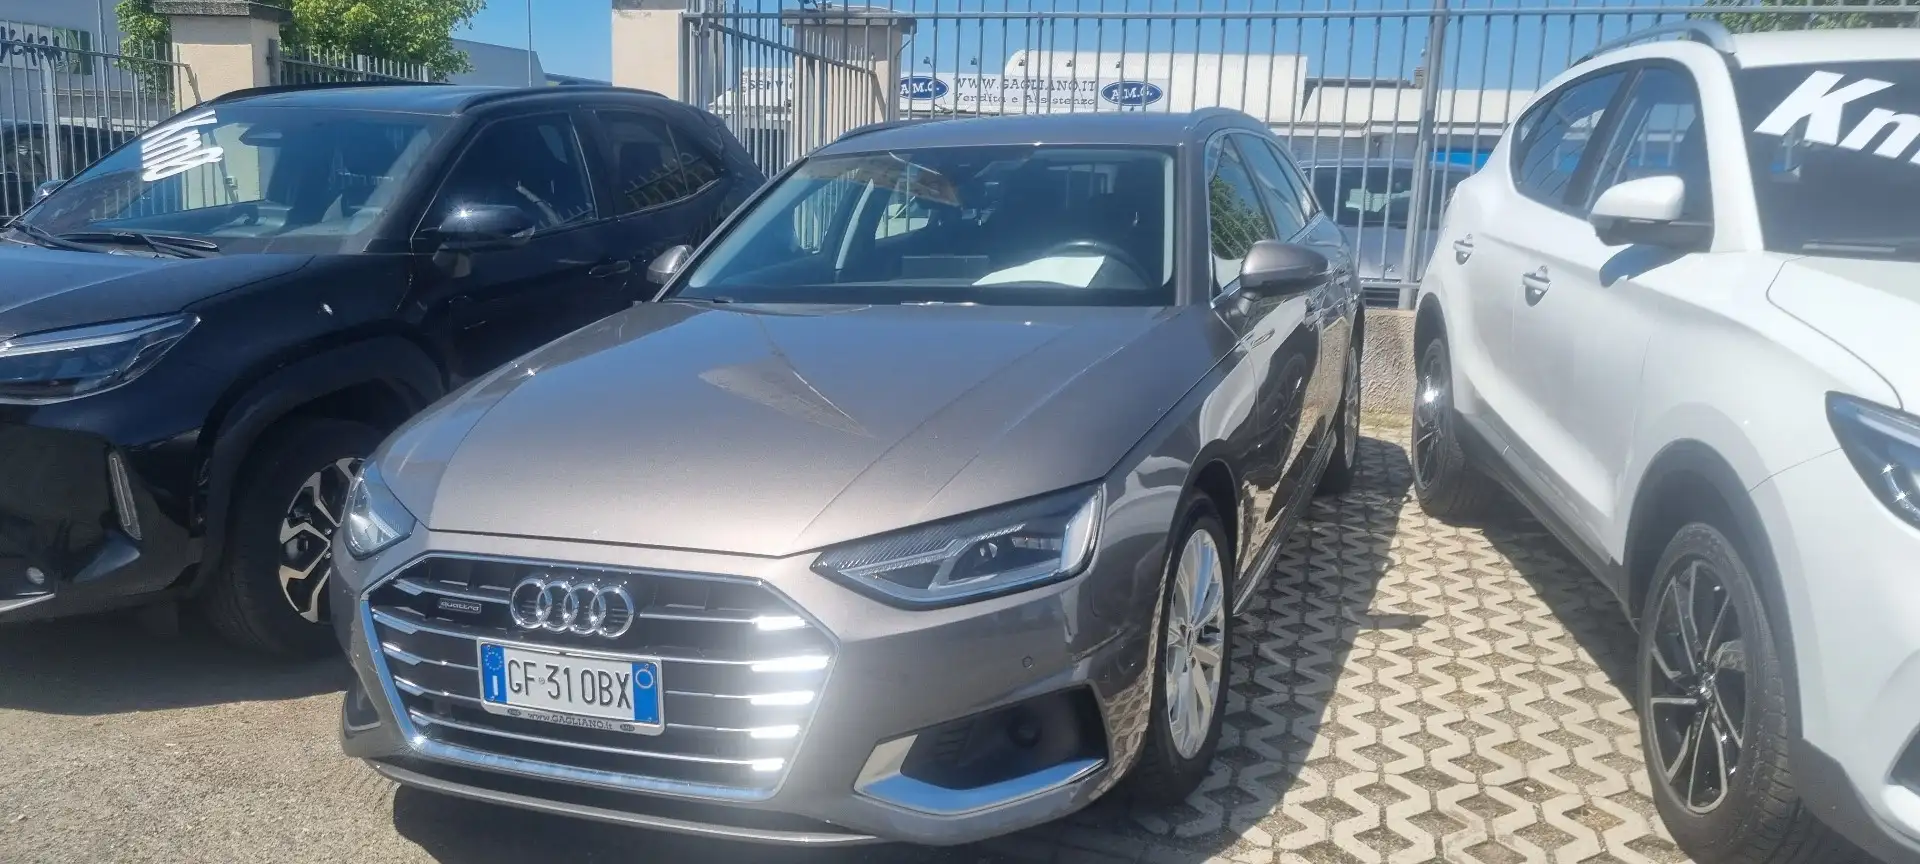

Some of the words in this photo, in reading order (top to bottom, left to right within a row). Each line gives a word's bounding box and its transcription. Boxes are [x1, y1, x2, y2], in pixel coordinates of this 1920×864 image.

[900, 81, 940, 94] AM.G.
[1024, 94, 1096, 105] Asstenza
[440, 600, 480, 611] quattro
[528, 712, 613, 730] www.GAGLIANO.it
